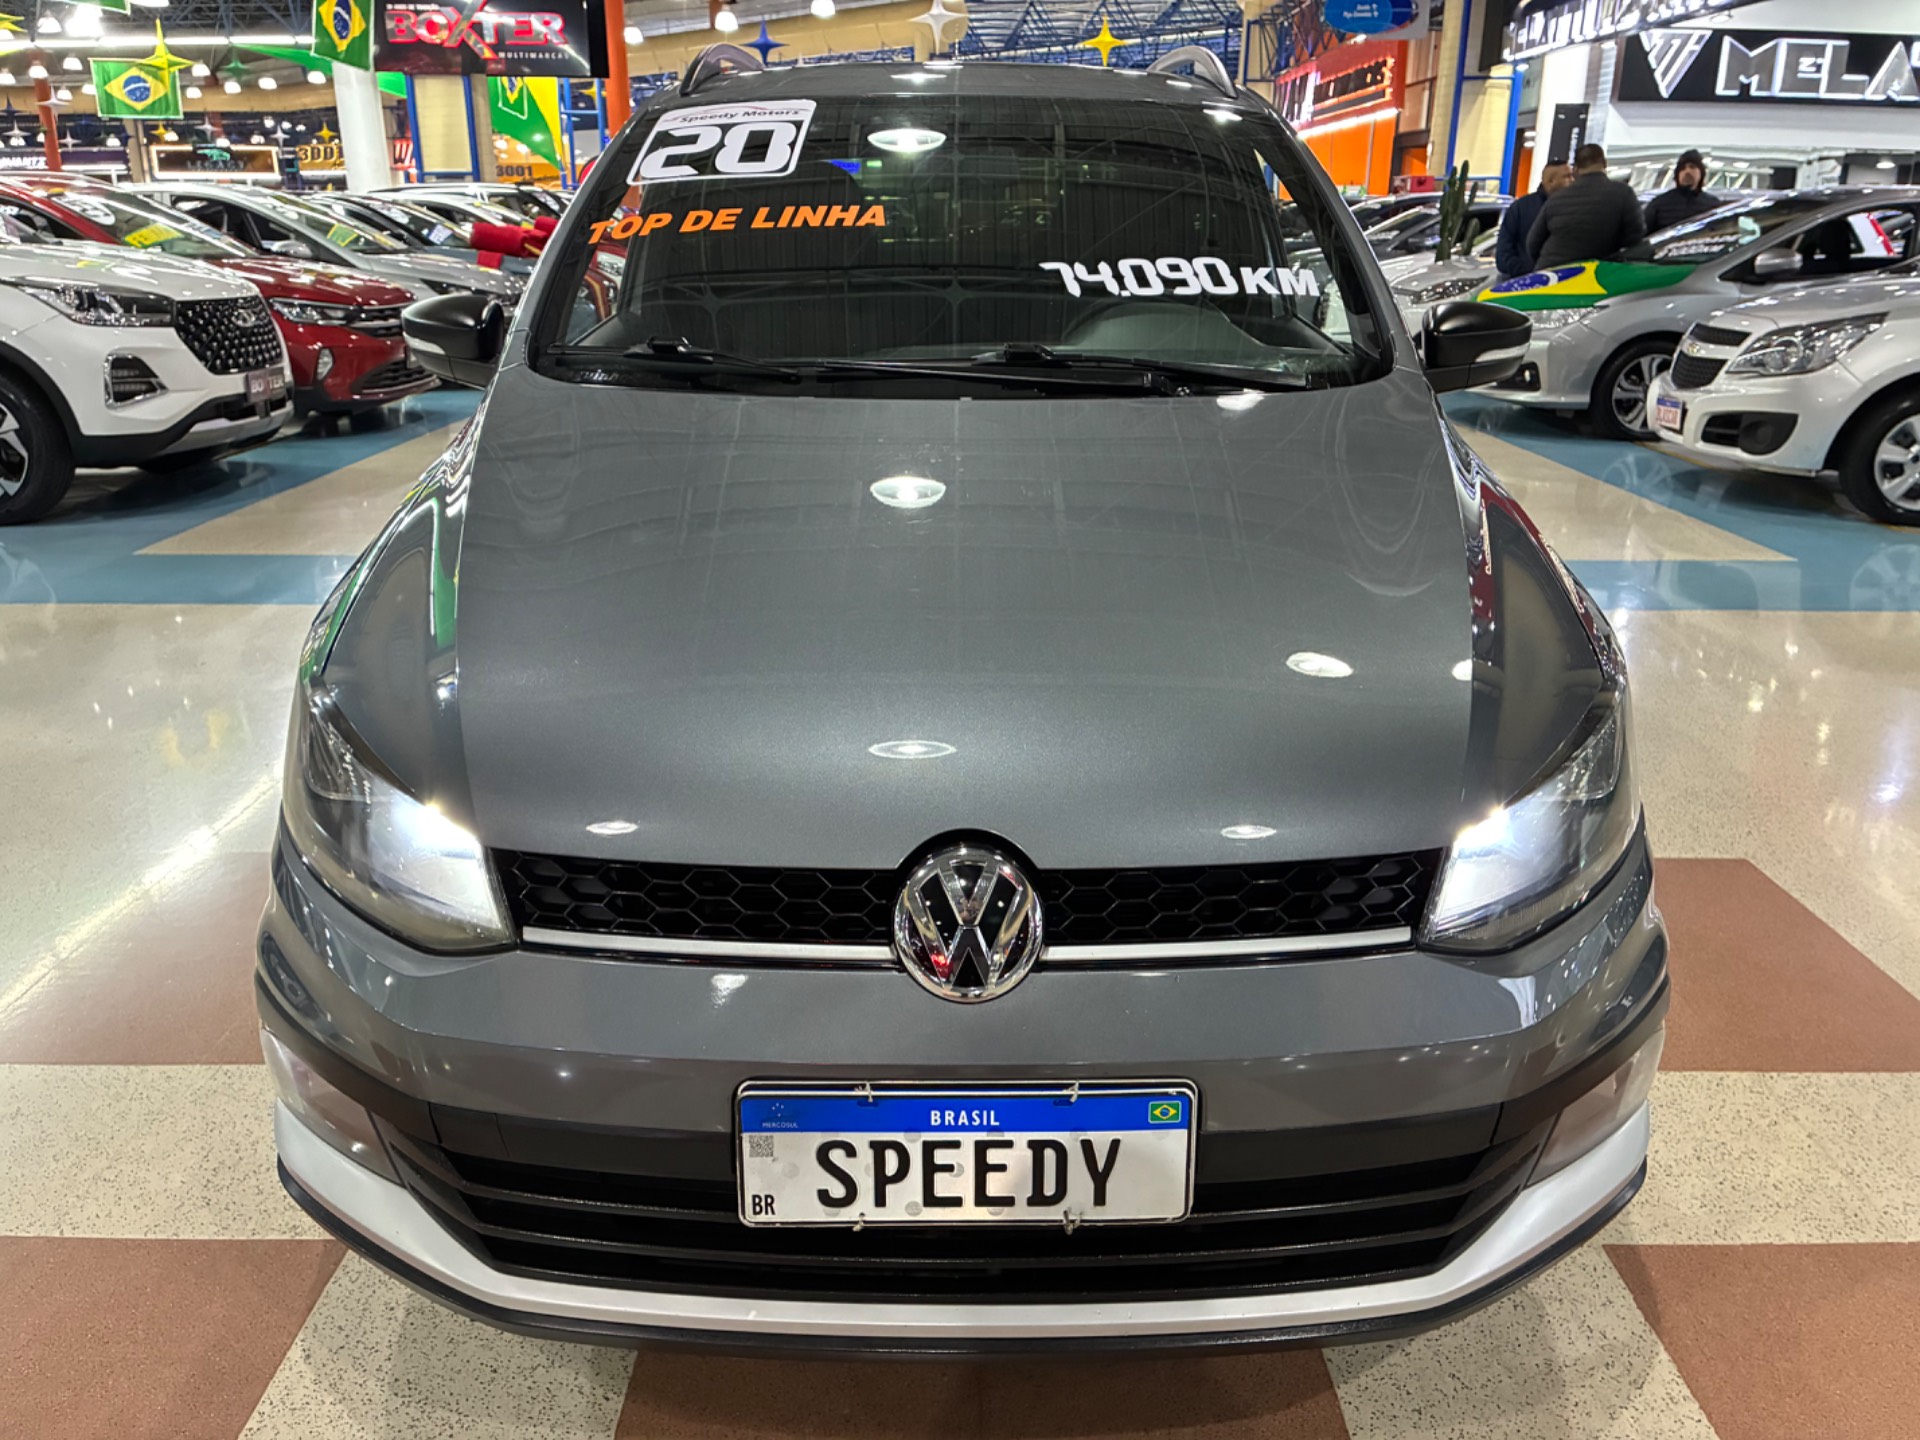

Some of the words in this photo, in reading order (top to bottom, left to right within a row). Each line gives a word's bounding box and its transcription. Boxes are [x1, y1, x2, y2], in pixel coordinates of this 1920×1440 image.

[385, 0, 568, 60] BOXTER
[679, 112, 739, 124] Speedy
[742, 109, 800, 118] Motors
[639, 121, 797, 179] 20
[588, 213, 673, 245] TOP
[679, 208, 743, 233] DE
[750, 205, 887, 229] LINHA
[761, 1121, 799, 1129] MERCOSUL
[929, 1109, 1001, 1127] BRASIL
[815, 1138, 1122, 1209] SPEEDY
[751, 1193, 777, 1217] BR
